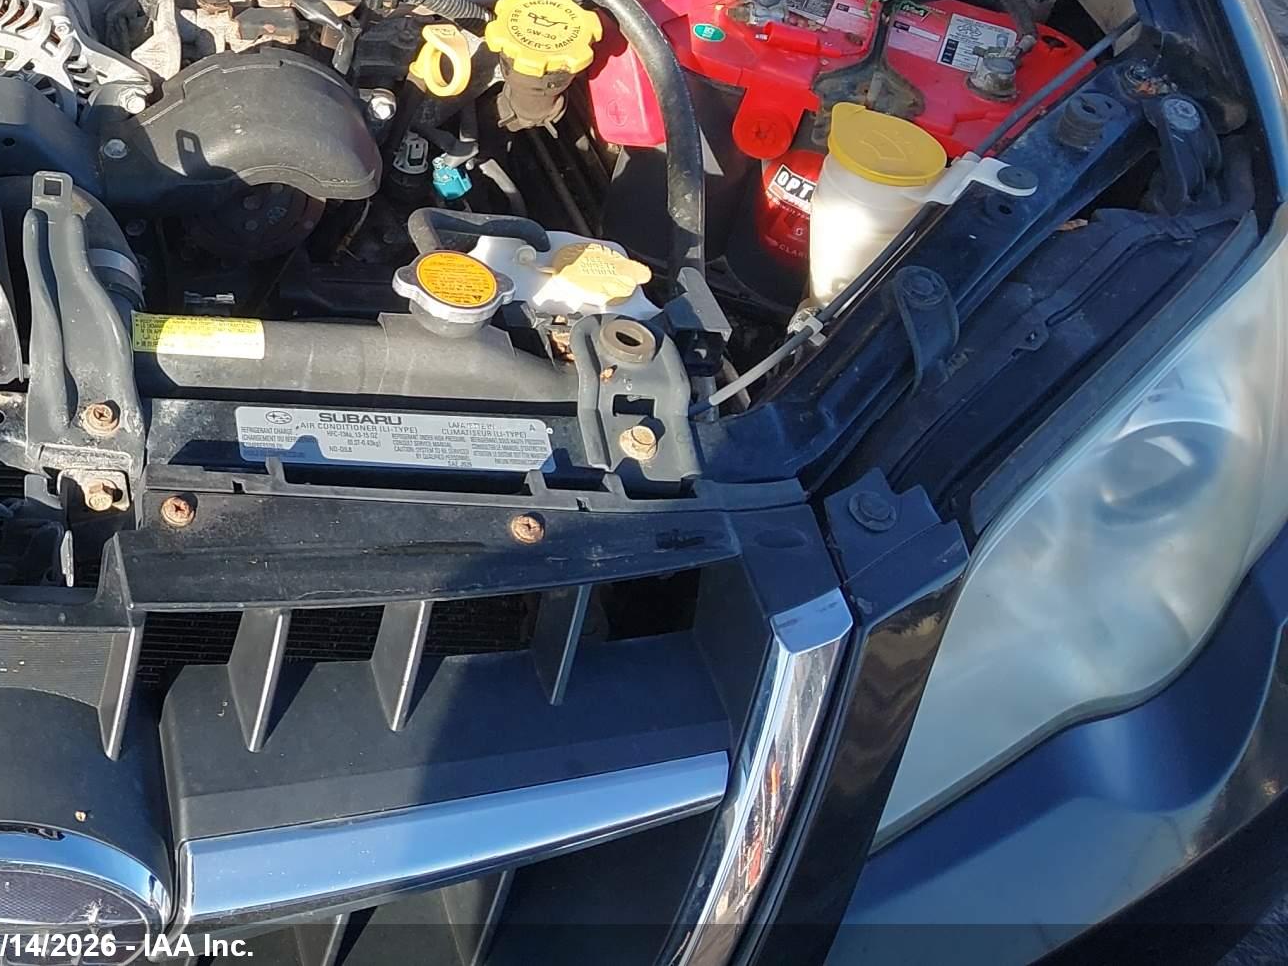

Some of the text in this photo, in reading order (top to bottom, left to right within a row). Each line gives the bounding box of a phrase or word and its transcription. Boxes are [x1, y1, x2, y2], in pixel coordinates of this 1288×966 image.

[523, 0, 579, 21] ENGINE OIL
[510, 9, 581, 50] SEE OWNER'S MANUAL
[774, 169, 813, 202] OPT
[300, 421, 315, 430] AIR
[317, 422, 378, 433] CONDITIONER
[318, 412, 402, 425] SUBARU
